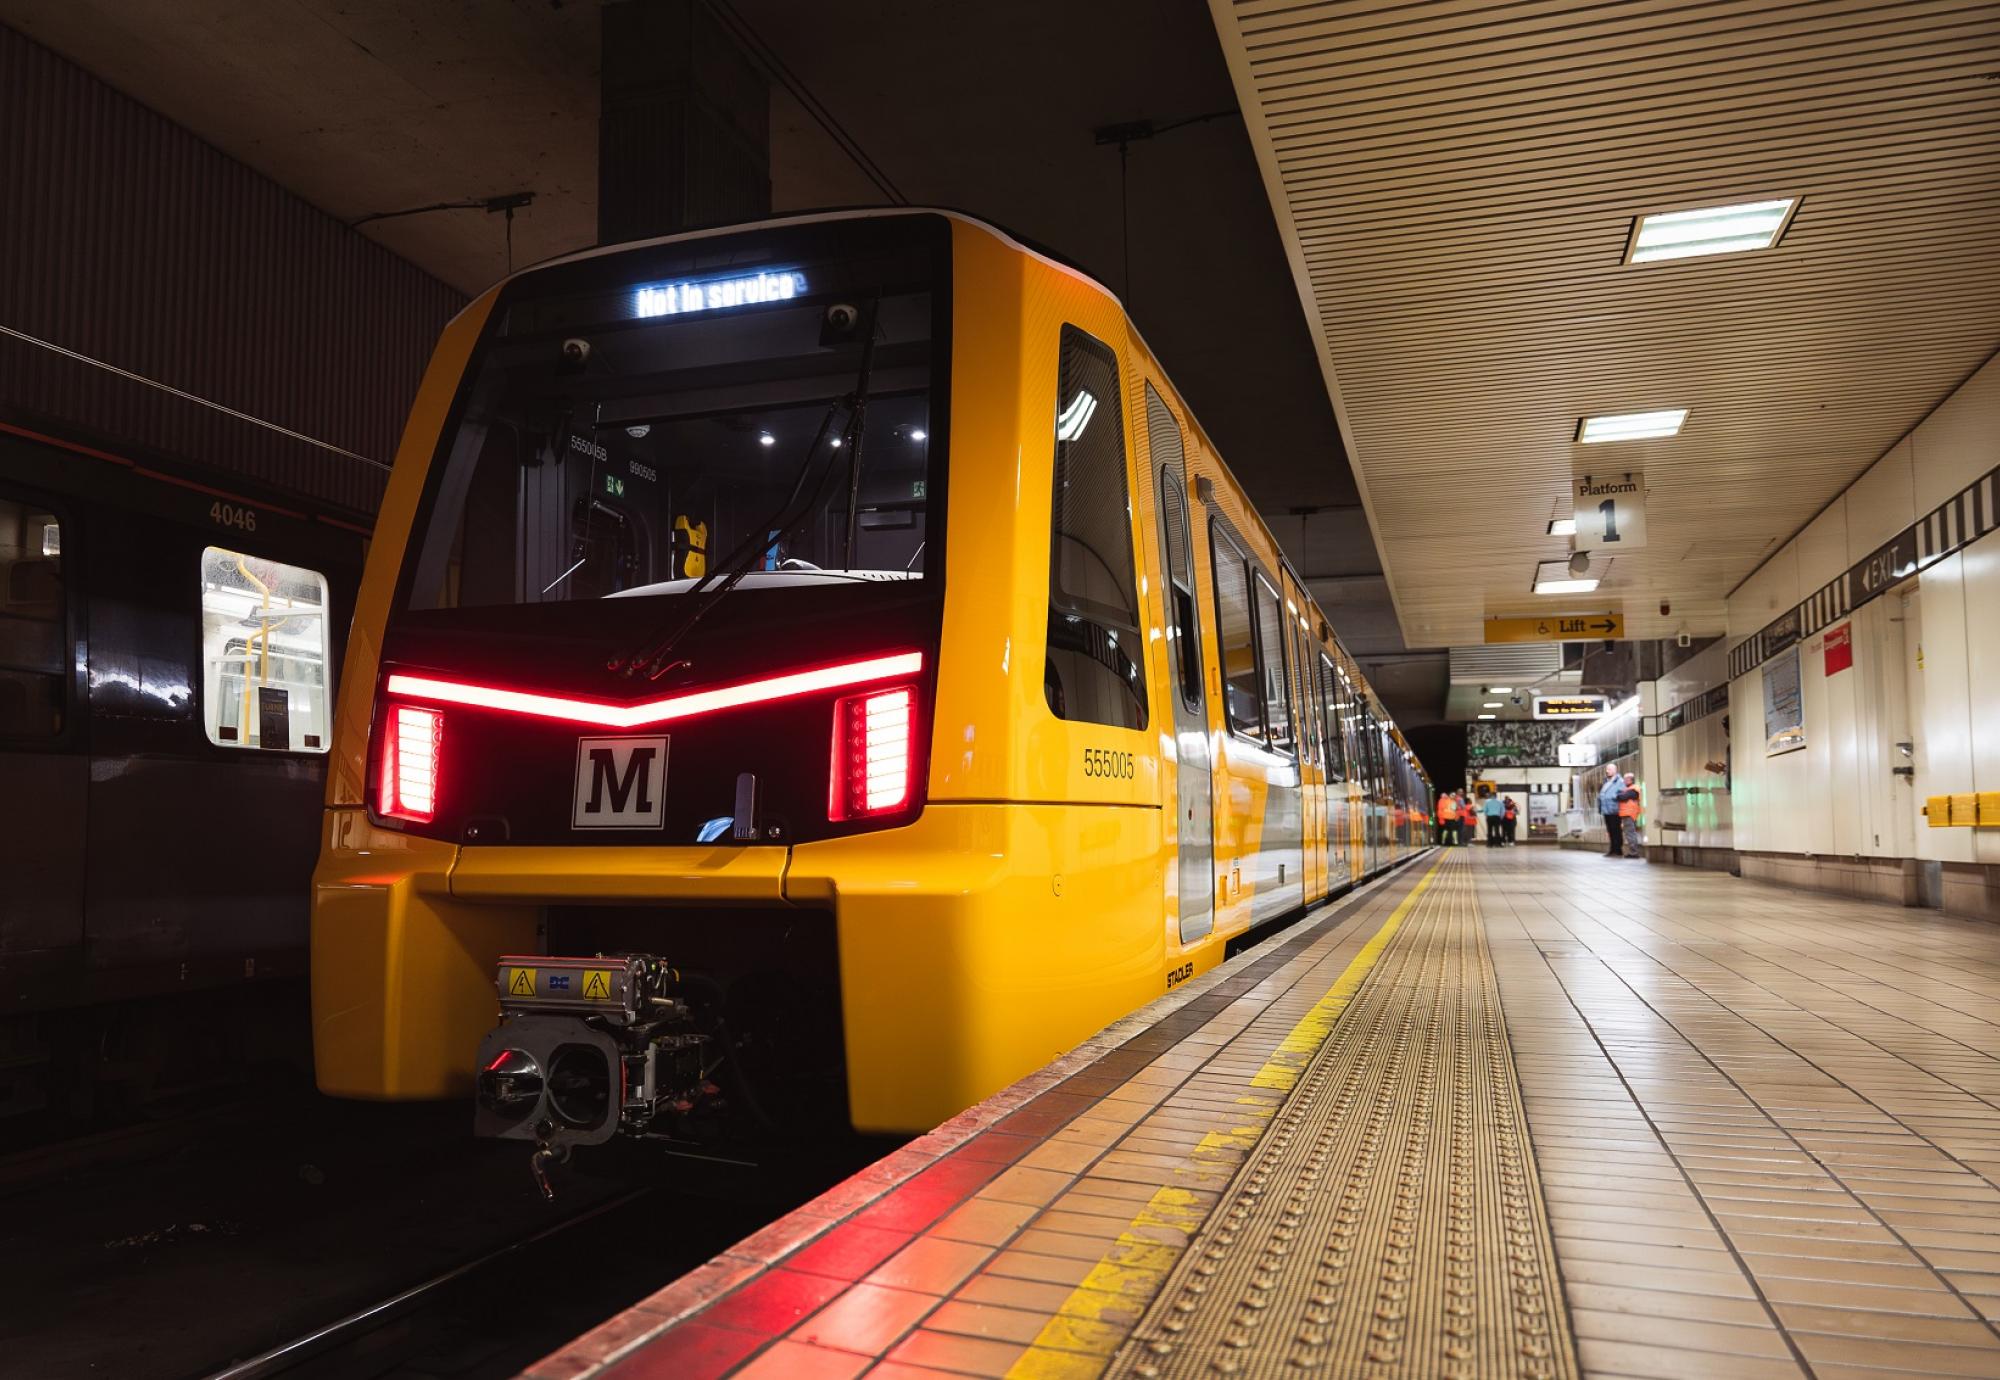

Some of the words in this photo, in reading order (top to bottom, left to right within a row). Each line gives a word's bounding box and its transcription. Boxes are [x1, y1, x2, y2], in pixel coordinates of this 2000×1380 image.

[638, 284, 678, 318] Not
[682, 282, 703, 313] in
[708, 271, 795, 309] service
[1579, 483, 1637, 497] Platform
[210, 501, 256, 532] 4046
[1599, 498, 1620, 542] 1
[1872, 546, 1899, 589] EXIT
[1559, 620, 1586, 633] Lift
[585, 747, 656, 813] M
[1084, 748, 1134, 780] 555005
[1167, 961, 1194, 989] STADLER
